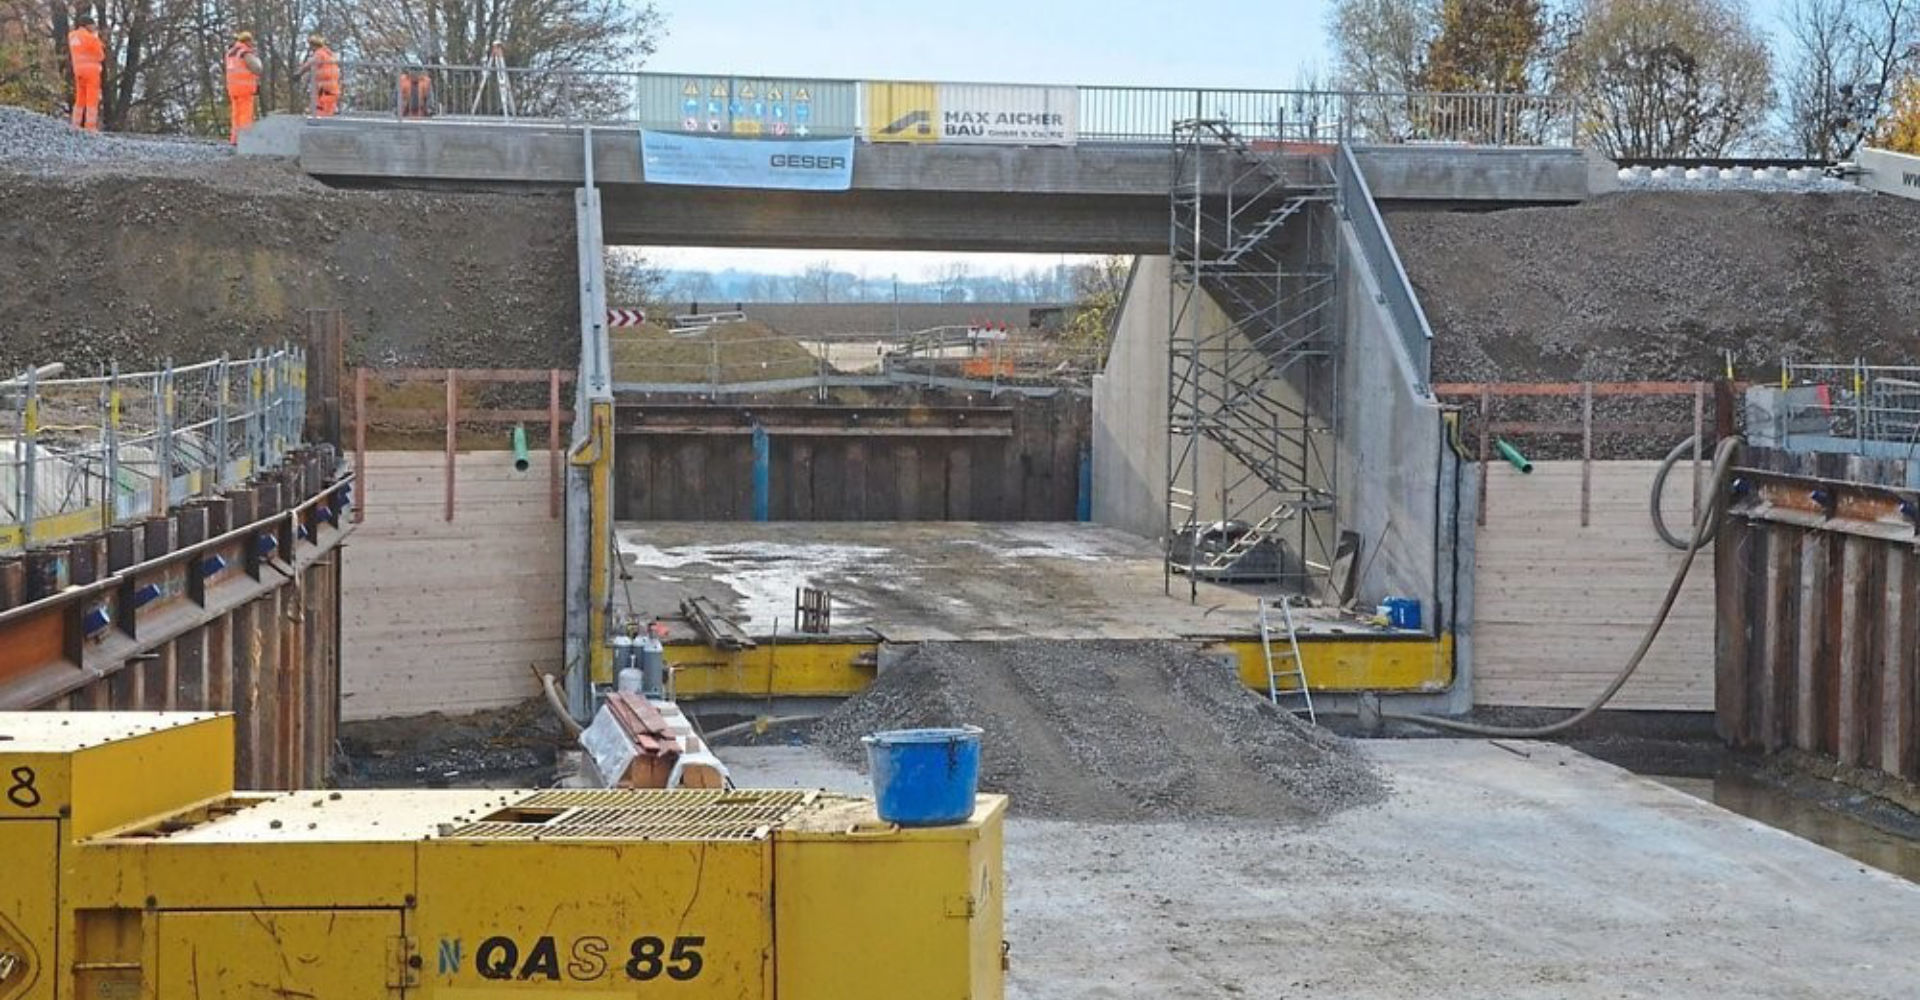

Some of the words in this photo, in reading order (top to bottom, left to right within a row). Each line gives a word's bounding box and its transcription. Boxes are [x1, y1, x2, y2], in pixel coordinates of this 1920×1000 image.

[944, 111, 989, 123] MAX
[995, 112, 1063, 125] AICHER
[944, 124, 984, 136] BAU
[770, 154, 846, 169] GESER
[7, 765, 41, 808] 8
[475, 936, 609, 981] QAS
[625, 936, 706, 981] 85
